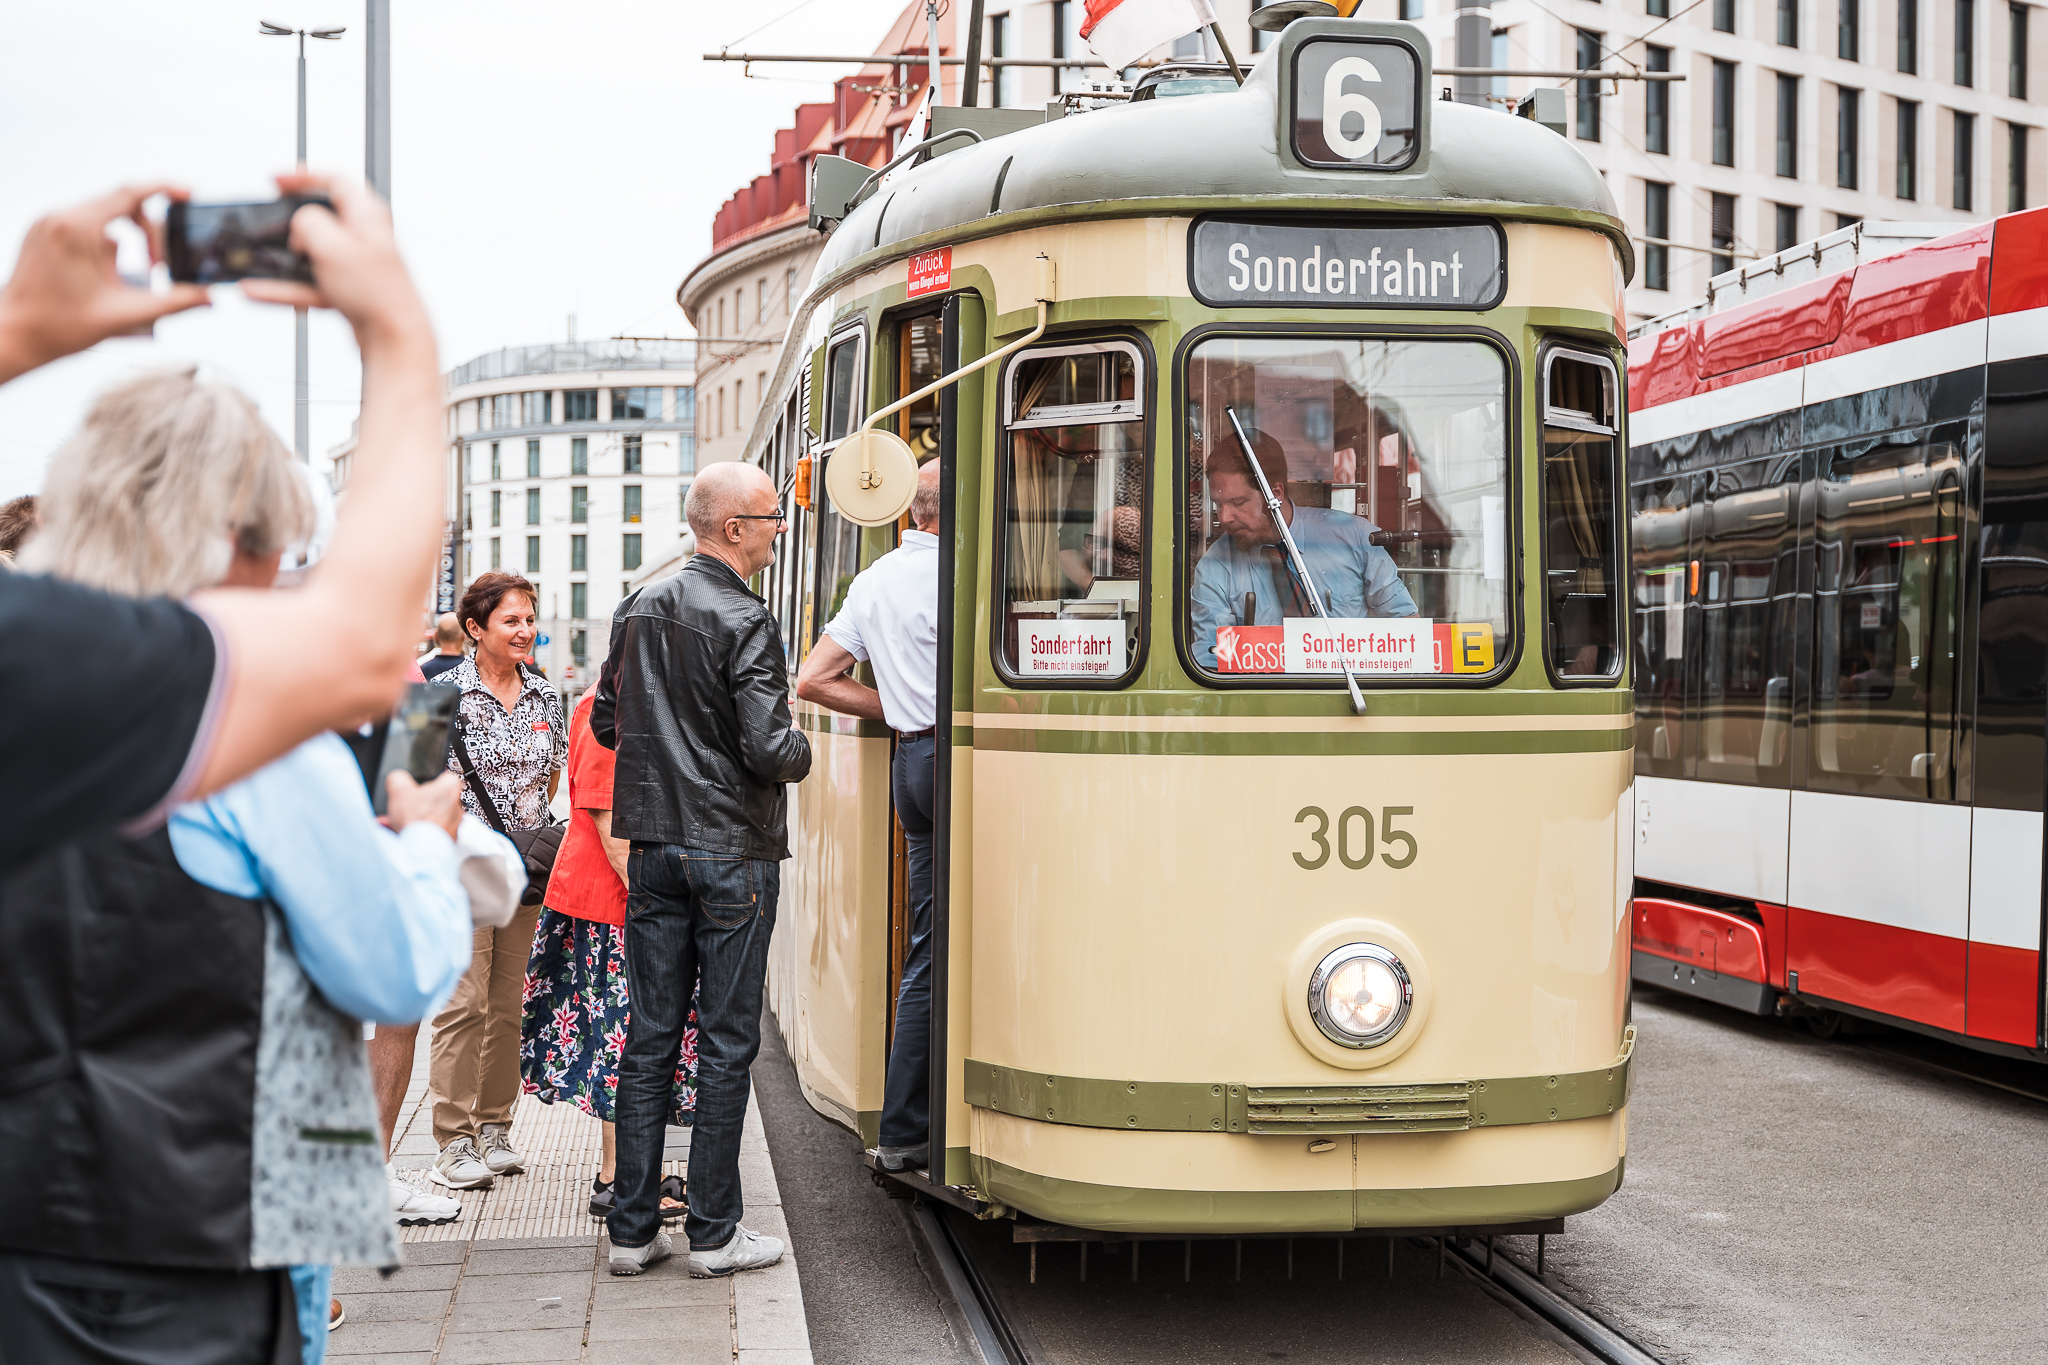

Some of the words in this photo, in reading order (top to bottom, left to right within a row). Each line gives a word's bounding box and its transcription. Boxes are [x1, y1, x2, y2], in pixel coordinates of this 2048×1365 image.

[1322, 56, 1383, 160] 6
[914, 251, 944, 275] Zurück
[1228, 242, 1463, 298] Sonderfahrt
[1031, 634, 1111, 655] Sonderfahrt
[1303, 633, 1416, 653] Sonderfahrt
[1462, 631, 1484, 666] E
[1033, 659, 1048, 670] Bitte
[1051, 660, 1068, 670] nicht
[1070, 660, 1109, 673] einsteigen!
[1306, 658, 1328, 669] Bitte
[1331, 658, 1356, 670] niht
[1359, 658, 1413, 671] einsteigen!
[1292, 805, 1418, 870] 305
